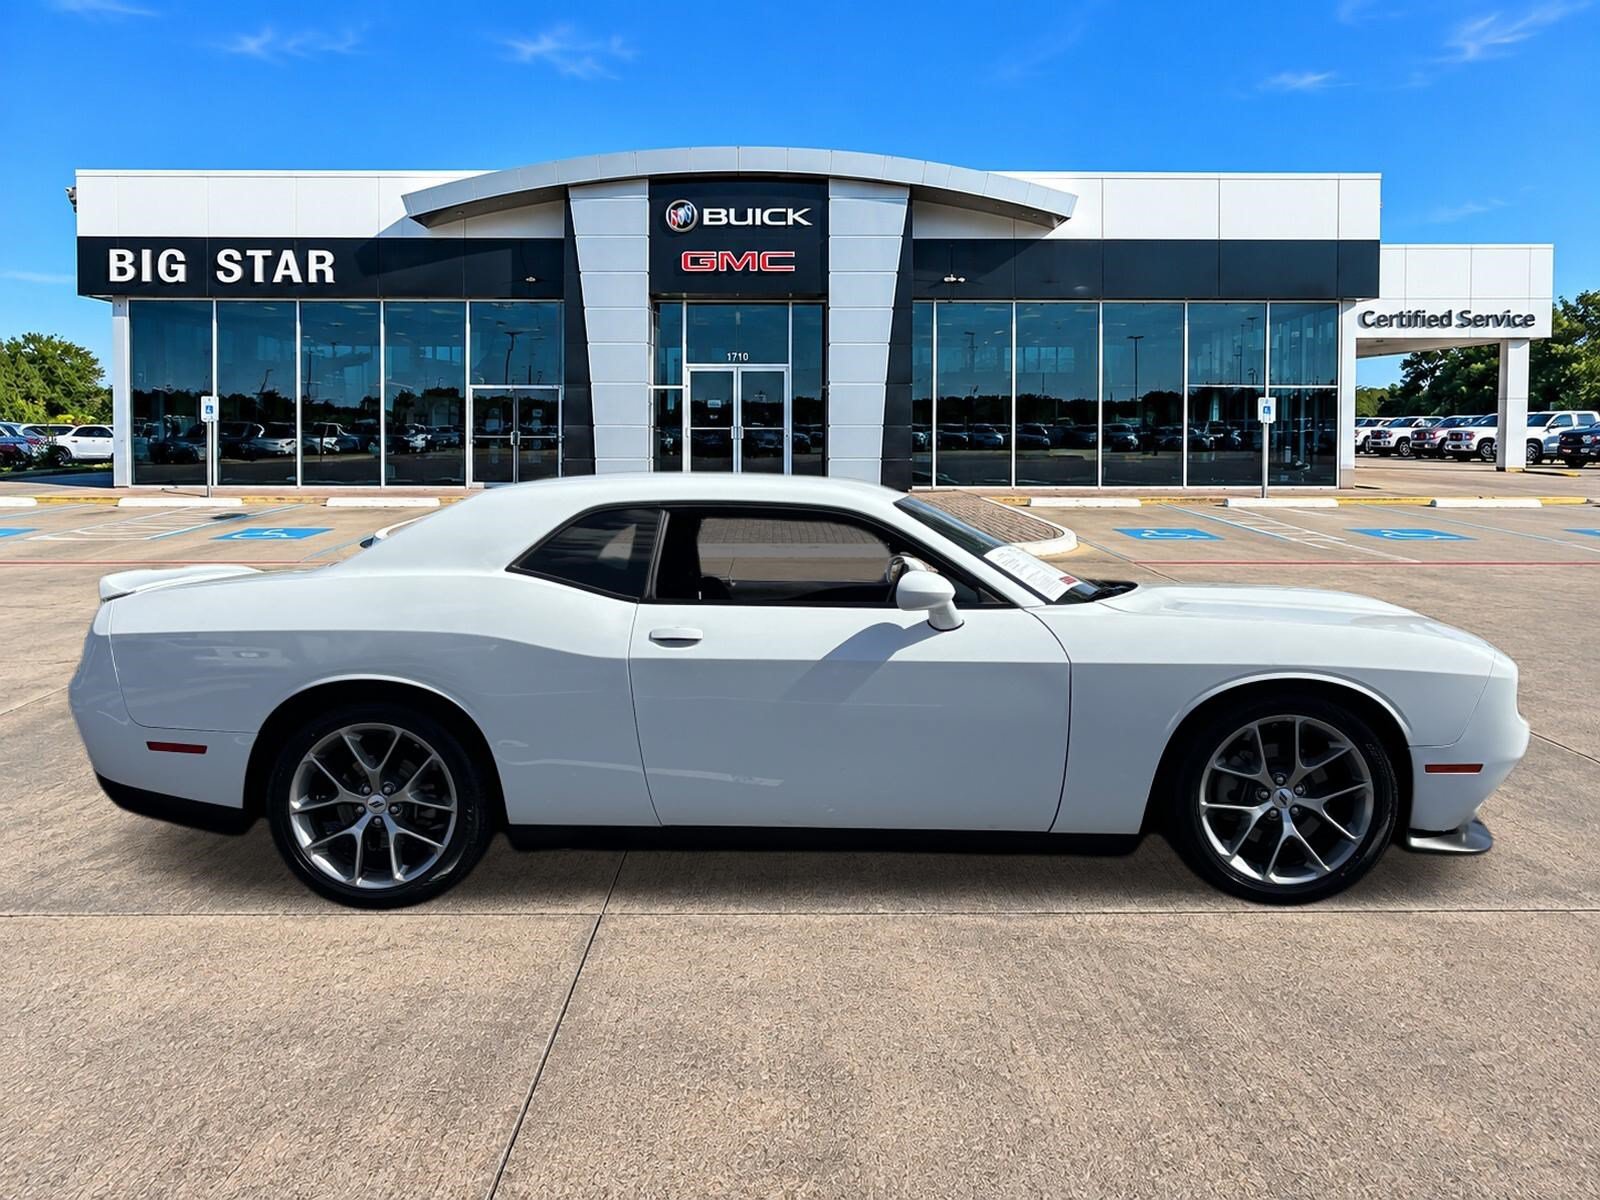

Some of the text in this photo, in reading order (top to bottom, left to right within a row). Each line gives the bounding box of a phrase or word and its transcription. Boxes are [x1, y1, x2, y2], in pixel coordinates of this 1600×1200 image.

[703, 208, 813, 226] BUICK
[108, 248, 336, 284] BIG STAR
[681, 251, 796, 272] GMC
[1361, 309, 1536, 328] Certified Service
[727, 352, 749, 361] 1710
